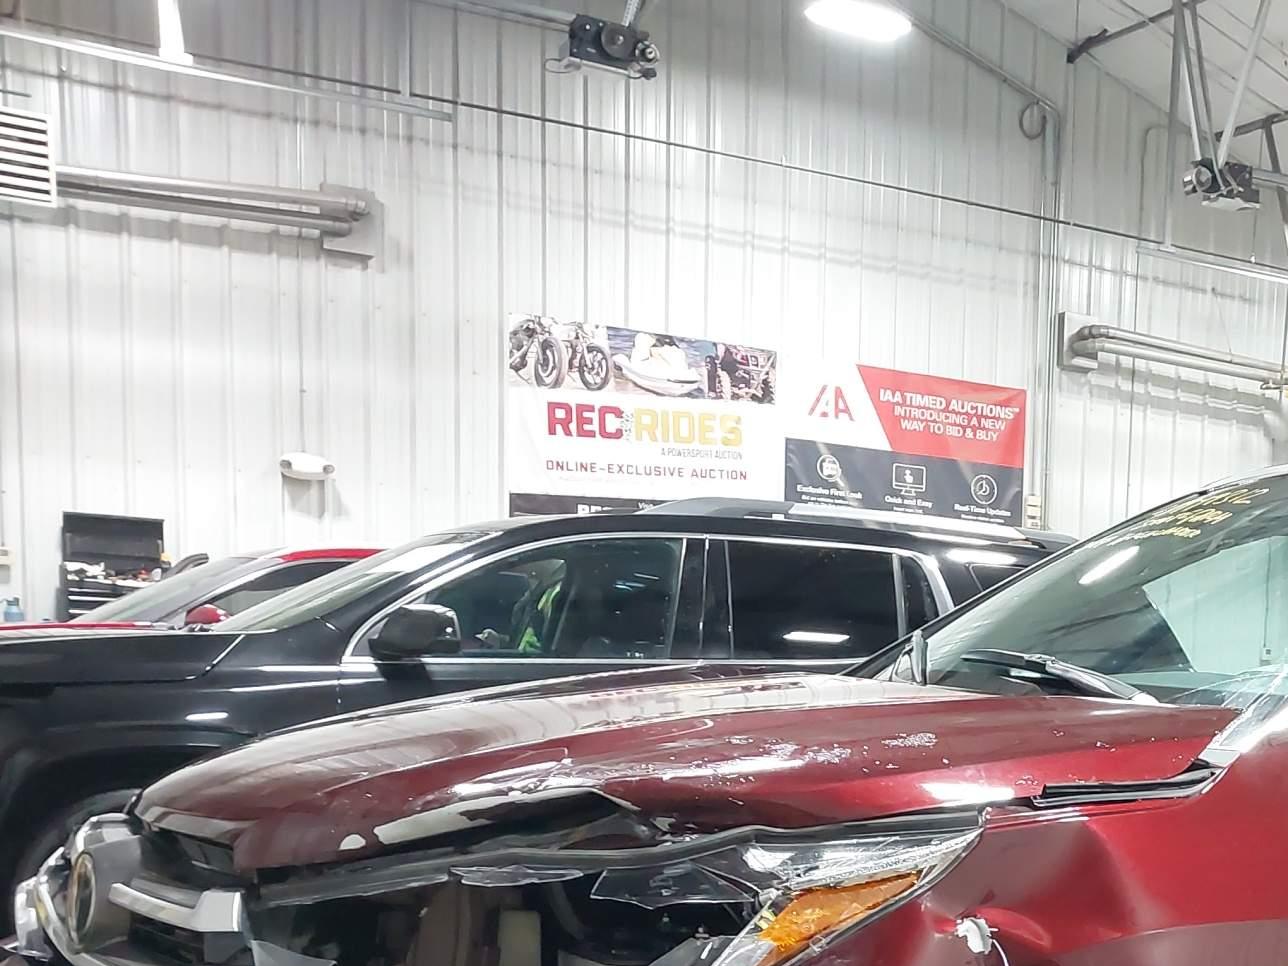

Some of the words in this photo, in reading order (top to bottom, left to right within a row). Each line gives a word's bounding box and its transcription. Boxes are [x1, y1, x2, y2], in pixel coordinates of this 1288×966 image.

[880, 389, 903, 404] IAA
[904, 392, 945, 410] TIMED
[547, 401, 624, 440] REC
[634, 407, 743, 447] RIDES
[894, 406, 968, 426] INTRODUCING
[970, 416, 978, 427] A
[981, 417, 1006, 431] NEW
[901, 418, 926, 432] WAY
[928, 422, 944, 435] TO
[946, 425, 963, 437] BID
[965, 428, 974, 438] &
[976, 429, 999, 442] BUY
[714, 451, 743, 461] AUCTION
[546, 460, 684, 478] ONLINE-EXCLUSIVE
[691, 468, 747, 481] AUCTION
